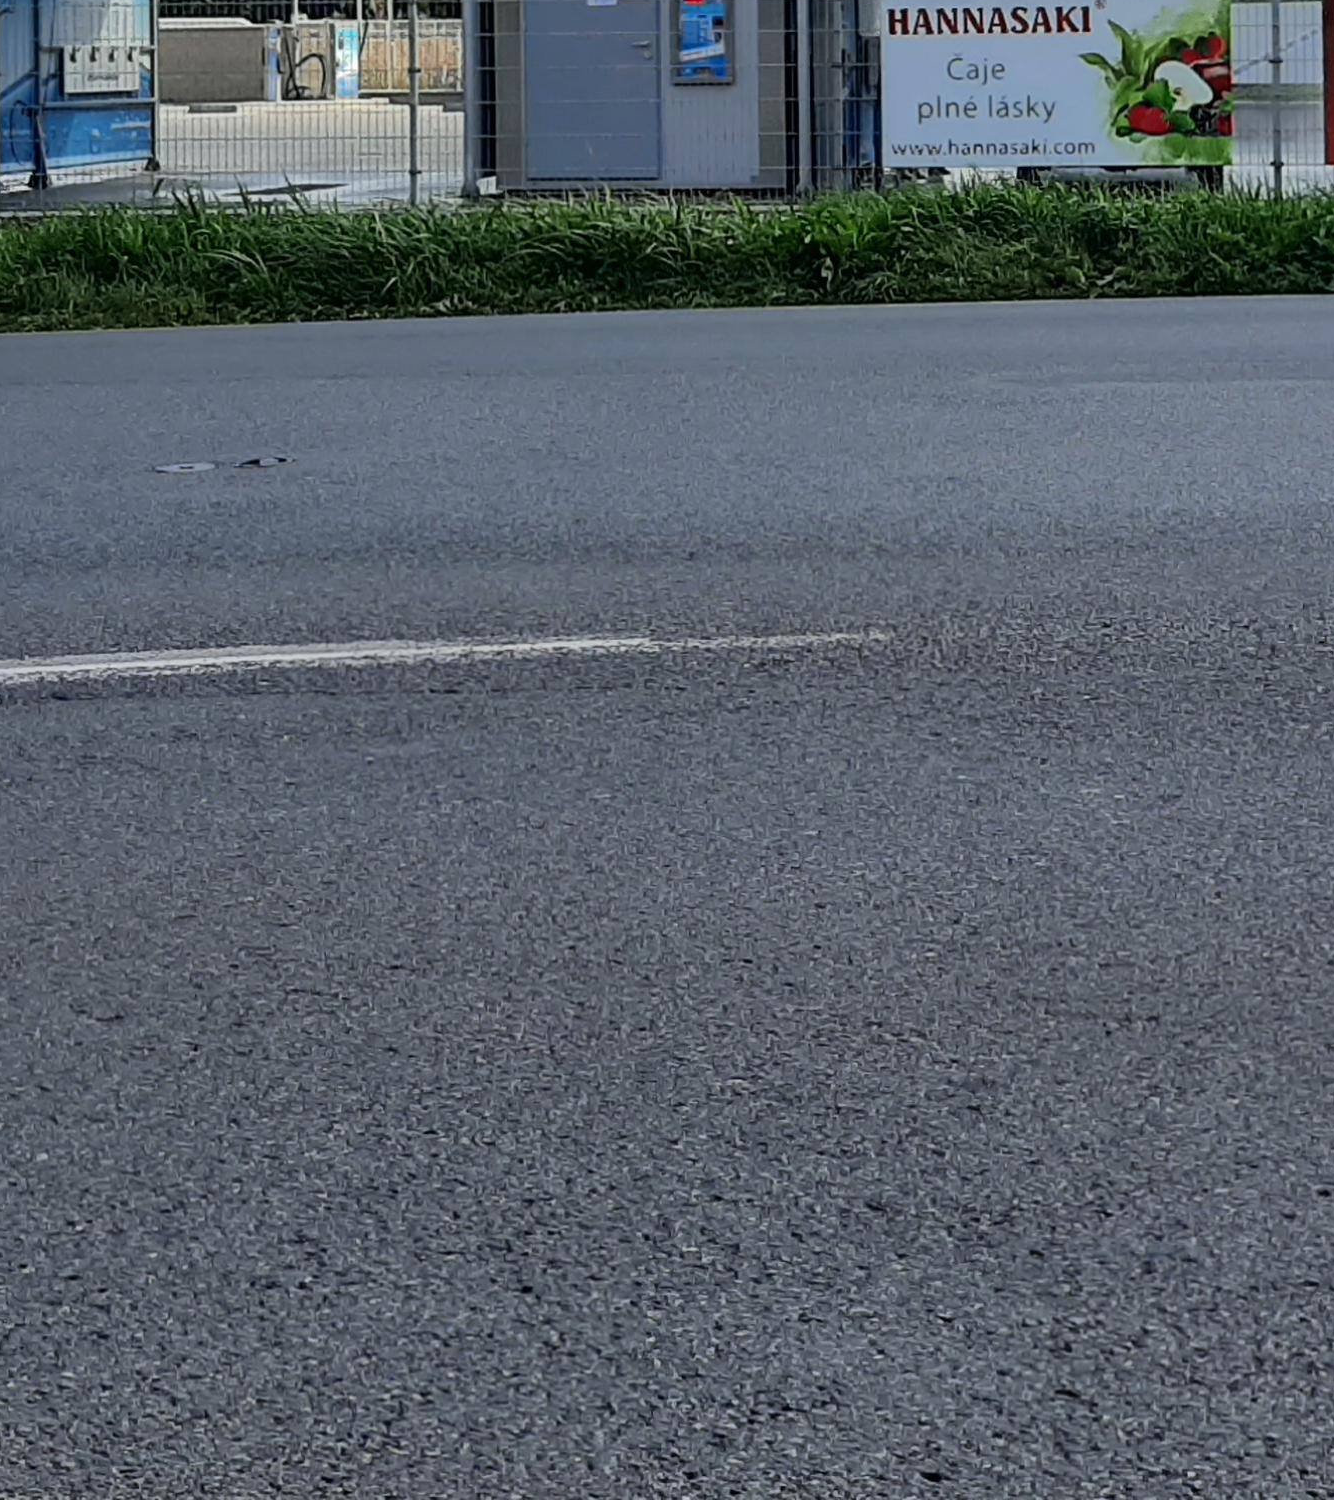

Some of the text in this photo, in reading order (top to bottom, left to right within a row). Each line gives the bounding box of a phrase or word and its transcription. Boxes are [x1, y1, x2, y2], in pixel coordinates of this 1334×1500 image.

[887, 5, 1092, 36] HANNASAKI
[946, 53, 1006, 86] Čaje
[917, 95, 1056, 124] plné lásky
[891, 138, 1096, 156] www.hannasaki.com
